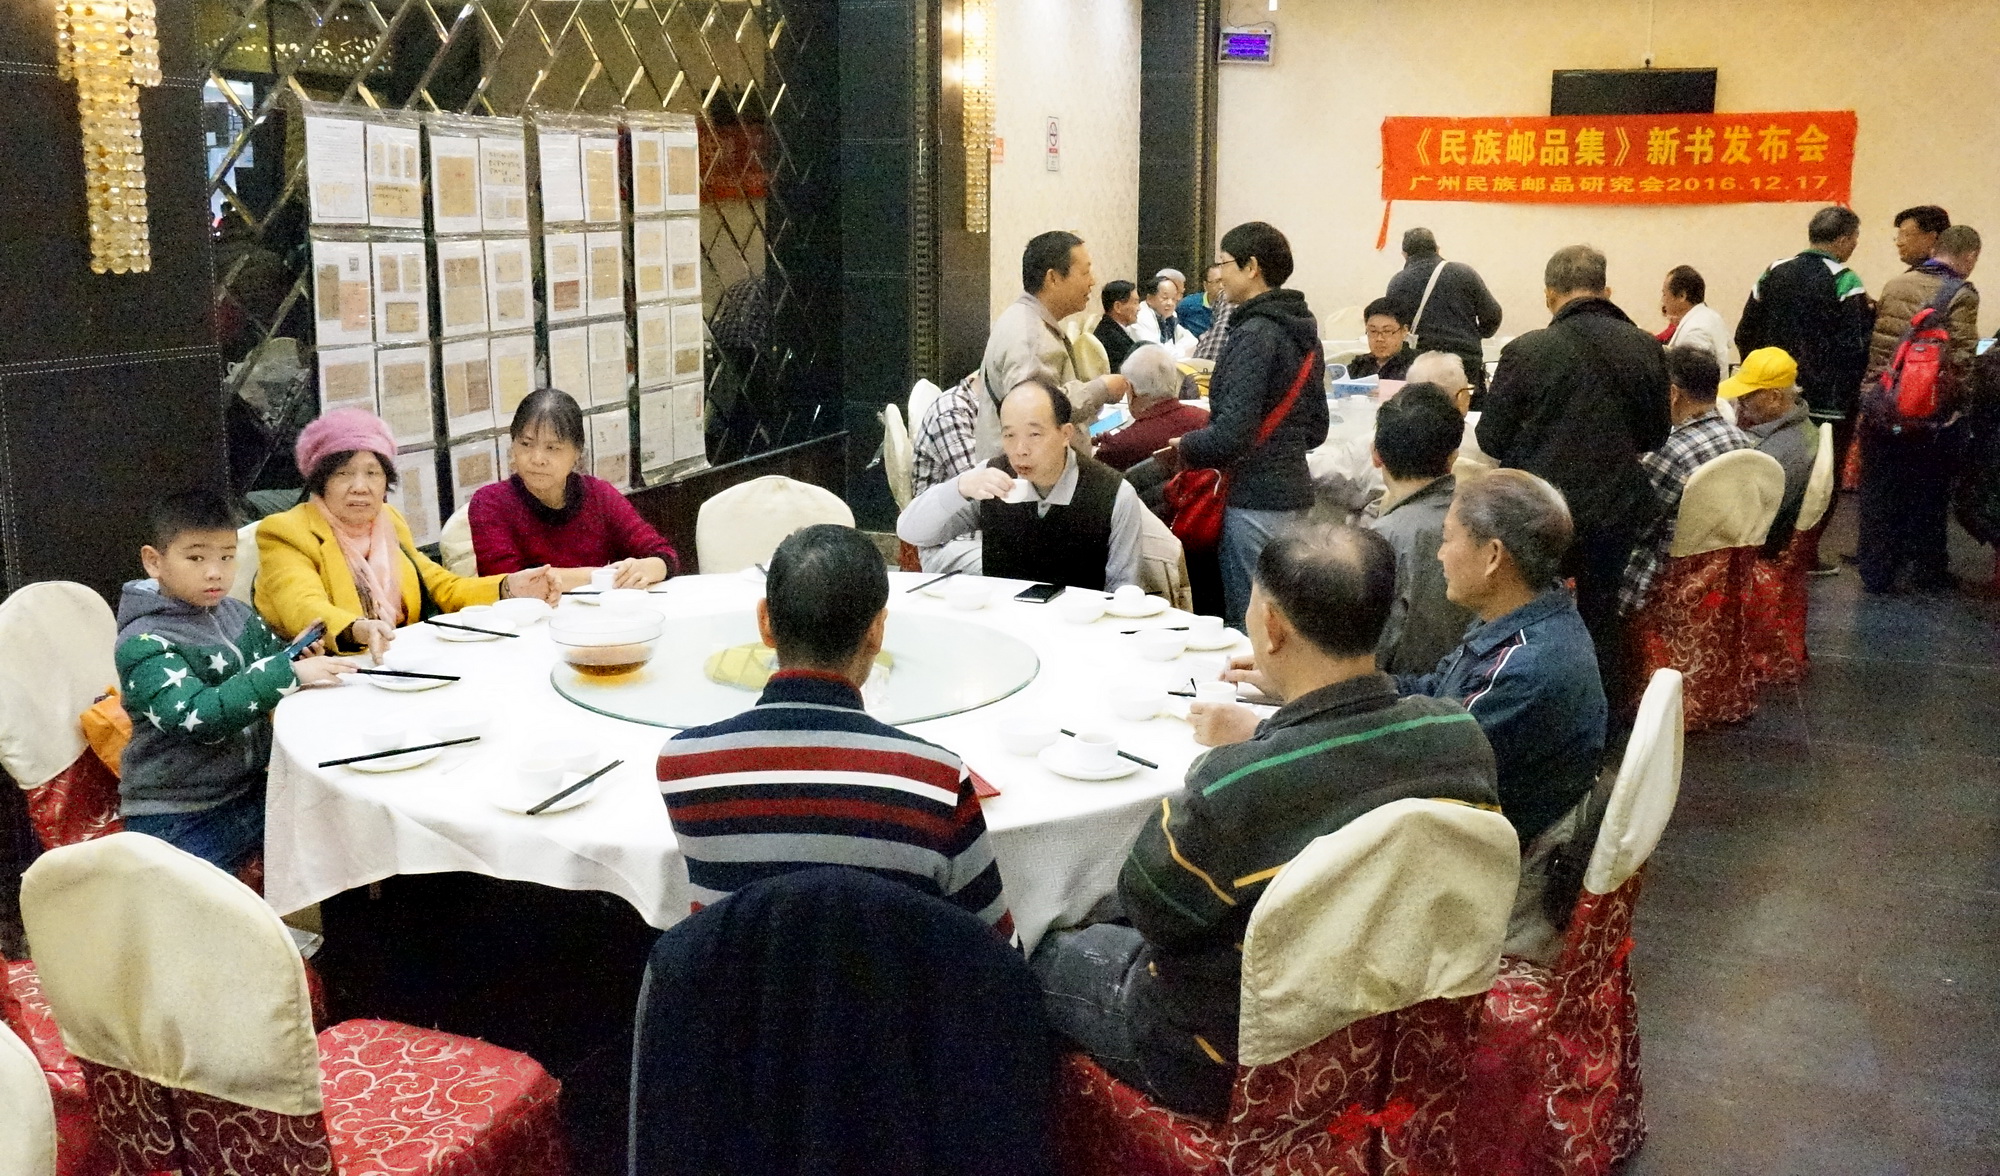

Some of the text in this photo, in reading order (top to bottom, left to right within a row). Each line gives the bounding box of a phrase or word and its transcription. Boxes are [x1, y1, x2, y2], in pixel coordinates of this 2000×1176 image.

[1416, 123, 1830, 166] 《民族邮品集》新书发布会
